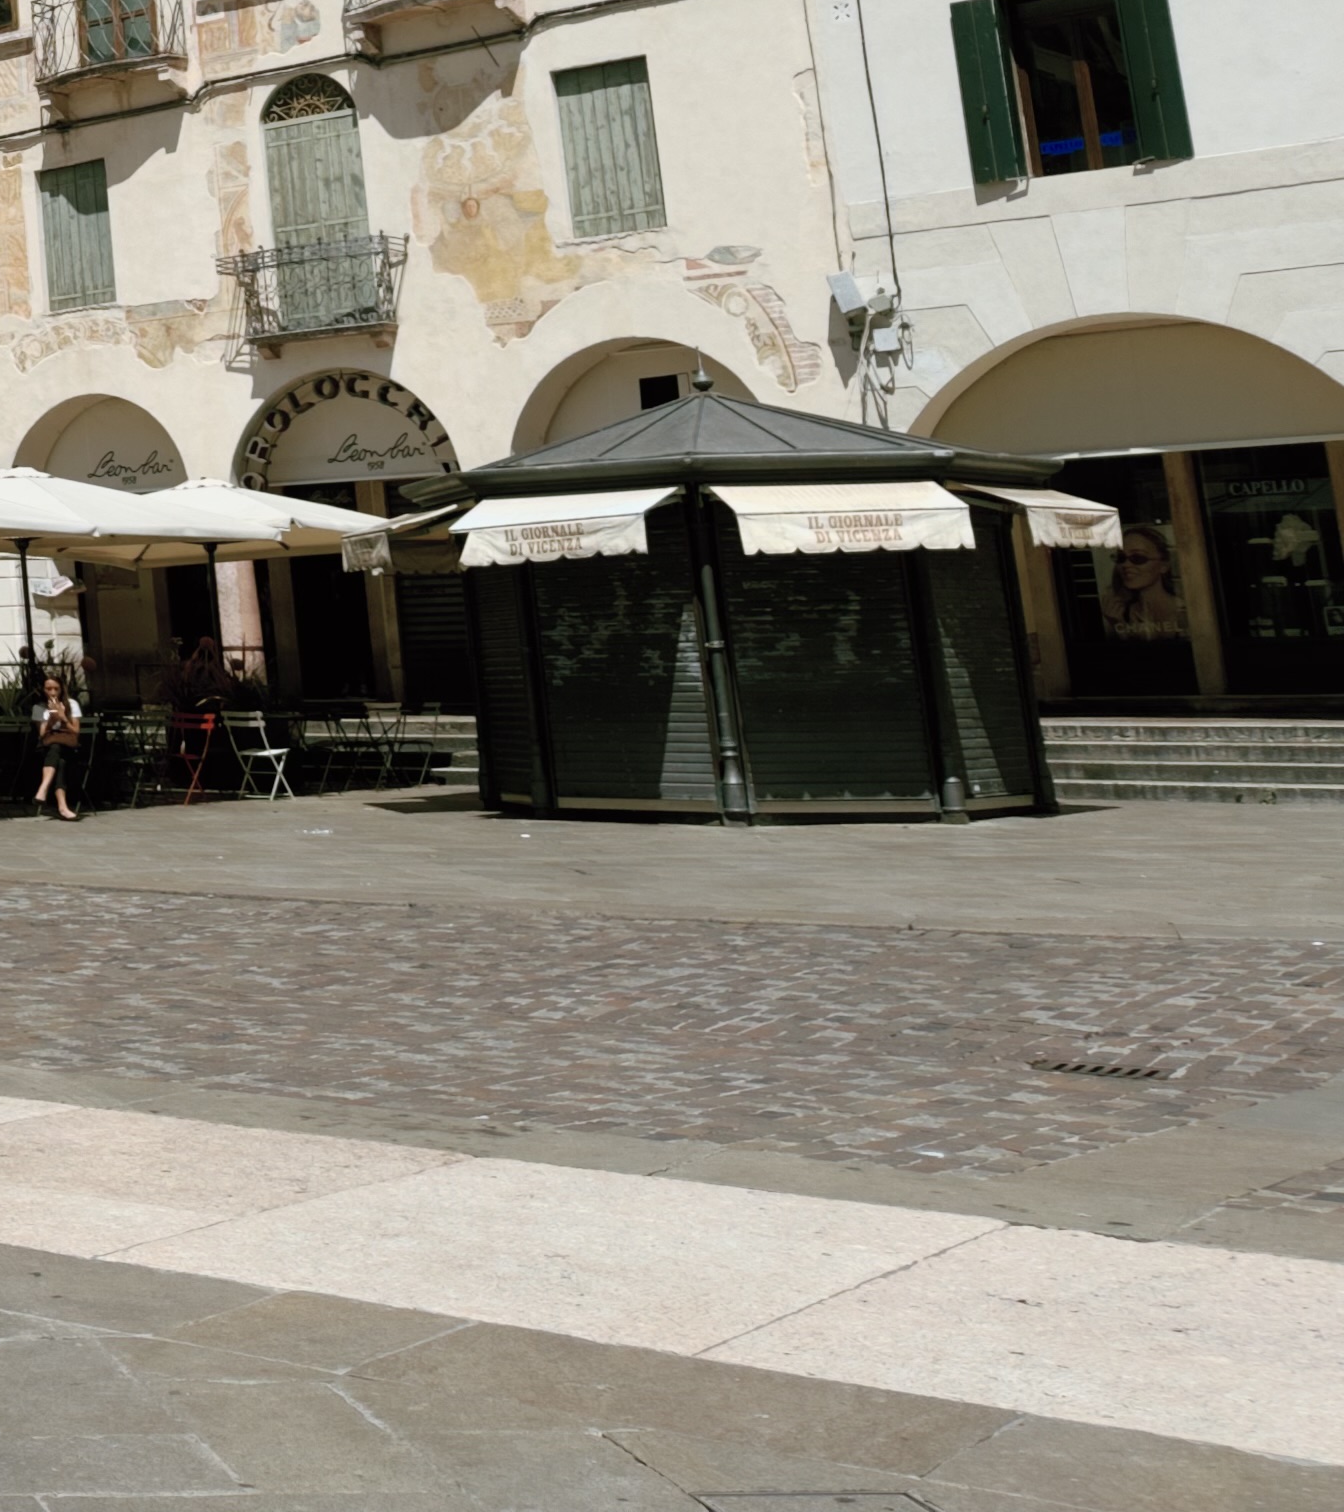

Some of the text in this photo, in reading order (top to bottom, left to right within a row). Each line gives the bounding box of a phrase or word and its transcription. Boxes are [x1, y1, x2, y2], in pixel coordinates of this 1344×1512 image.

[1229, 479, 1305, 496] CAPELLO
[807, 513, 904, 530] IL GIORNALE
[504, 523, 585, 543] IL GIORNALE
[814, 528, 903, 544] DI VICENZA
[509, 537, 583, 557] DI VICENZA
[1115, 621, 1183, 634] CHANEL
